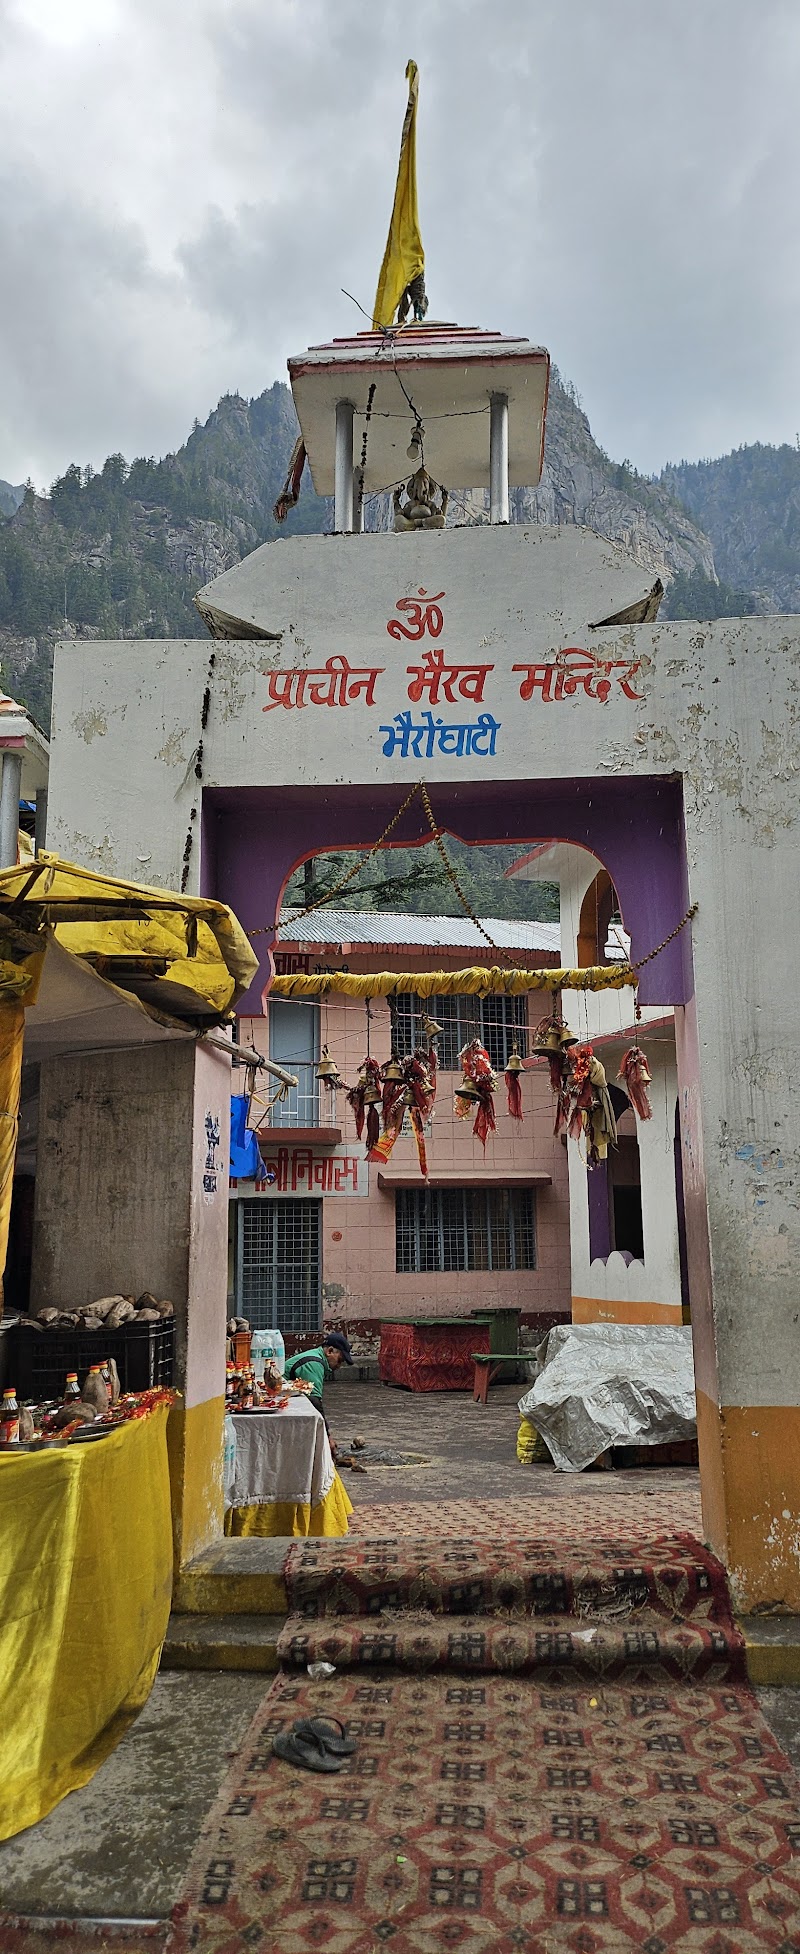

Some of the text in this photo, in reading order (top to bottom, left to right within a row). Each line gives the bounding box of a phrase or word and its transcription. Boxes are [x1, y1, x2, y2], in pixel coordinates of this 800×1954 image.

[262, 647, 648, 712] प्राचीन भैरव मन्दिर
[379, 711, 500, 758] भैरोंघाटी
